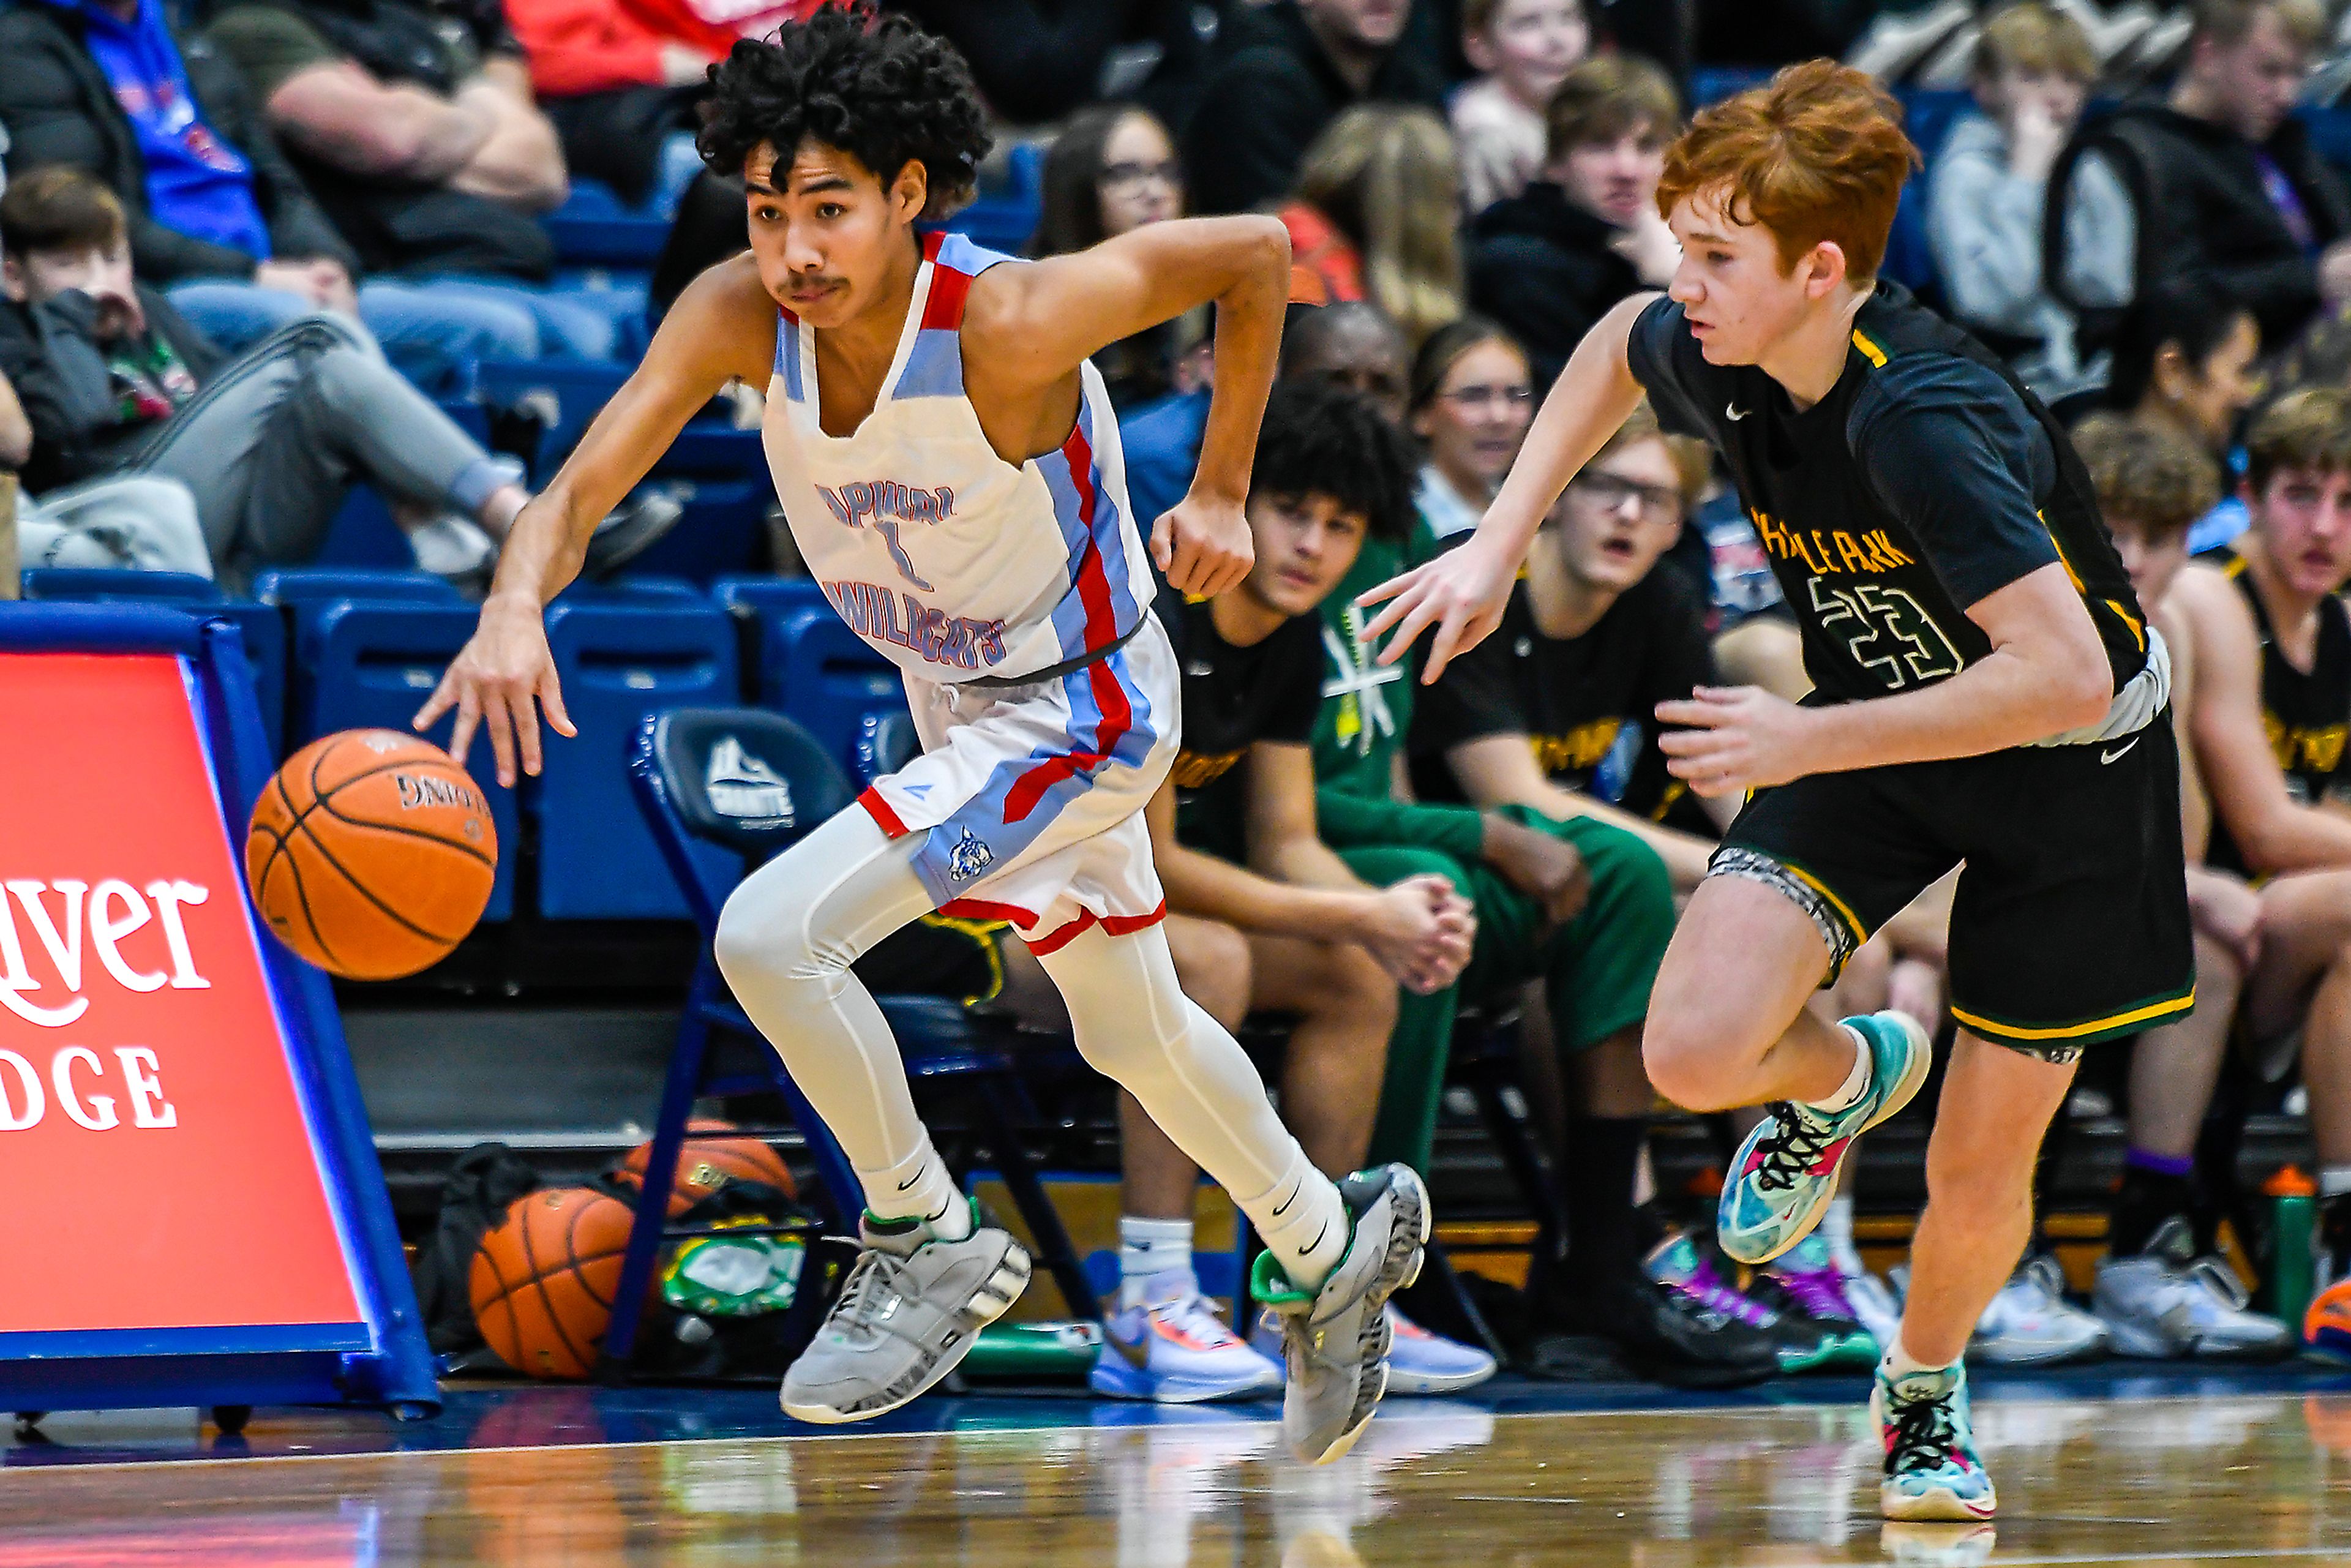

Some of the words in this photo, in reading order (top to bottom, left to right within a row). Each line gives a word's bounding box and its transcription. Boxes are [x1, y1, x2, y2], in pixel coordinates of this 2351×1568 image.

[822, 581, 1007, 669] WILDCATS
[1807, 576, 1964, 689] 23
[0, 879, 211, 1028] iver
